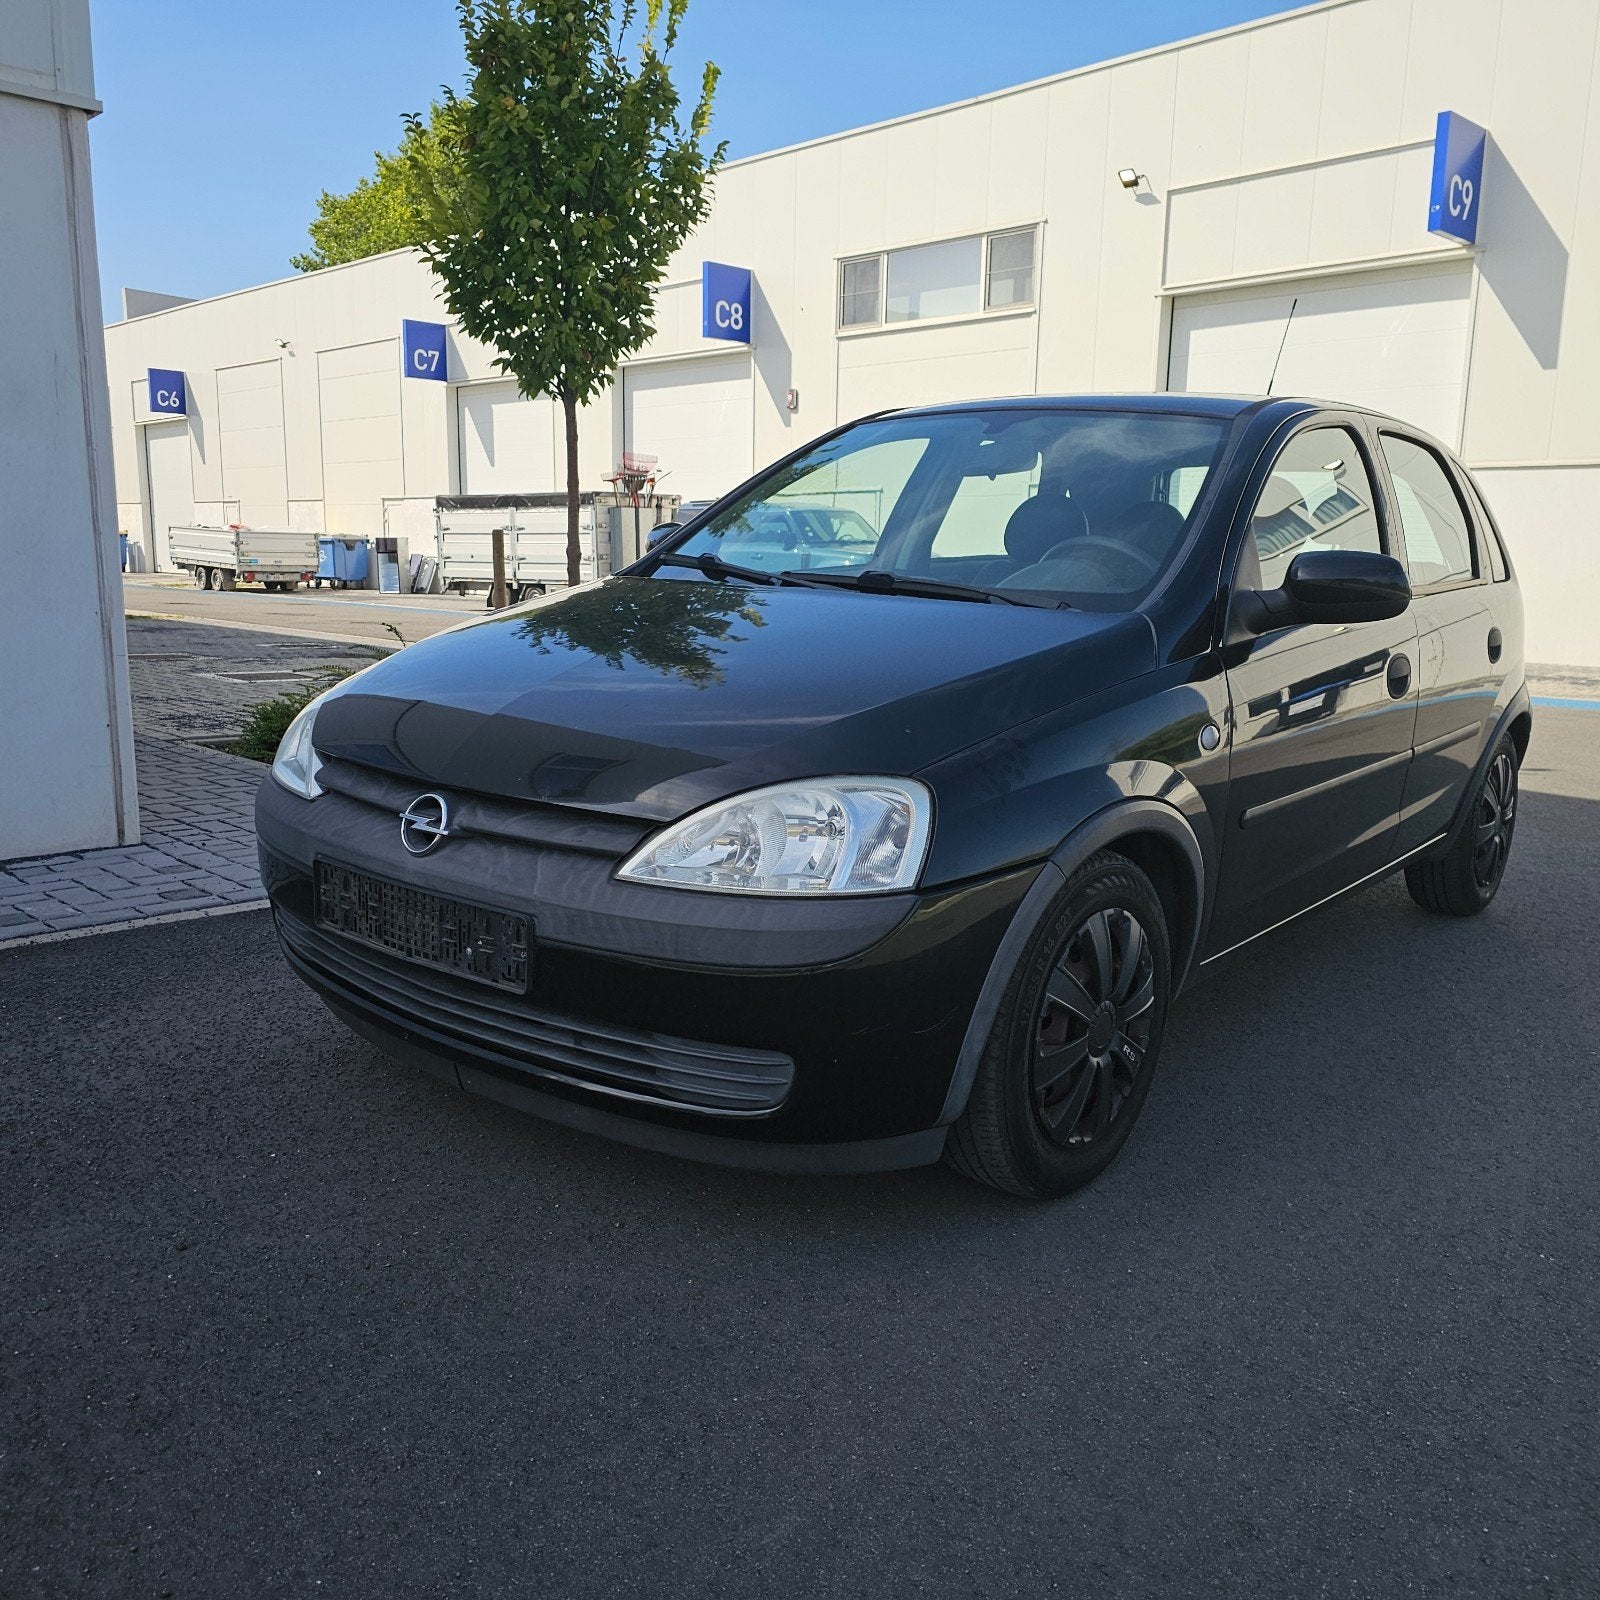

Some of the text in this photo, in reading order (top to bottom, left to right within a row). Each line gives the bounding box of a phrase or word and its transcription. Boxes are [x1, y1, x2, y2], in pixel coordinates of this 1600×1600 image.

[1449, 174, 1473, 220] C9
[716, 300, 743, 330] C8
[414, 348, 440, 371] C7
[157, 389, 180, 407] C6
[1036, 957, 1046, 971] R
[1043, 936, 1055, 954] 14
[1122, 1044, 1136, 1061] RS
